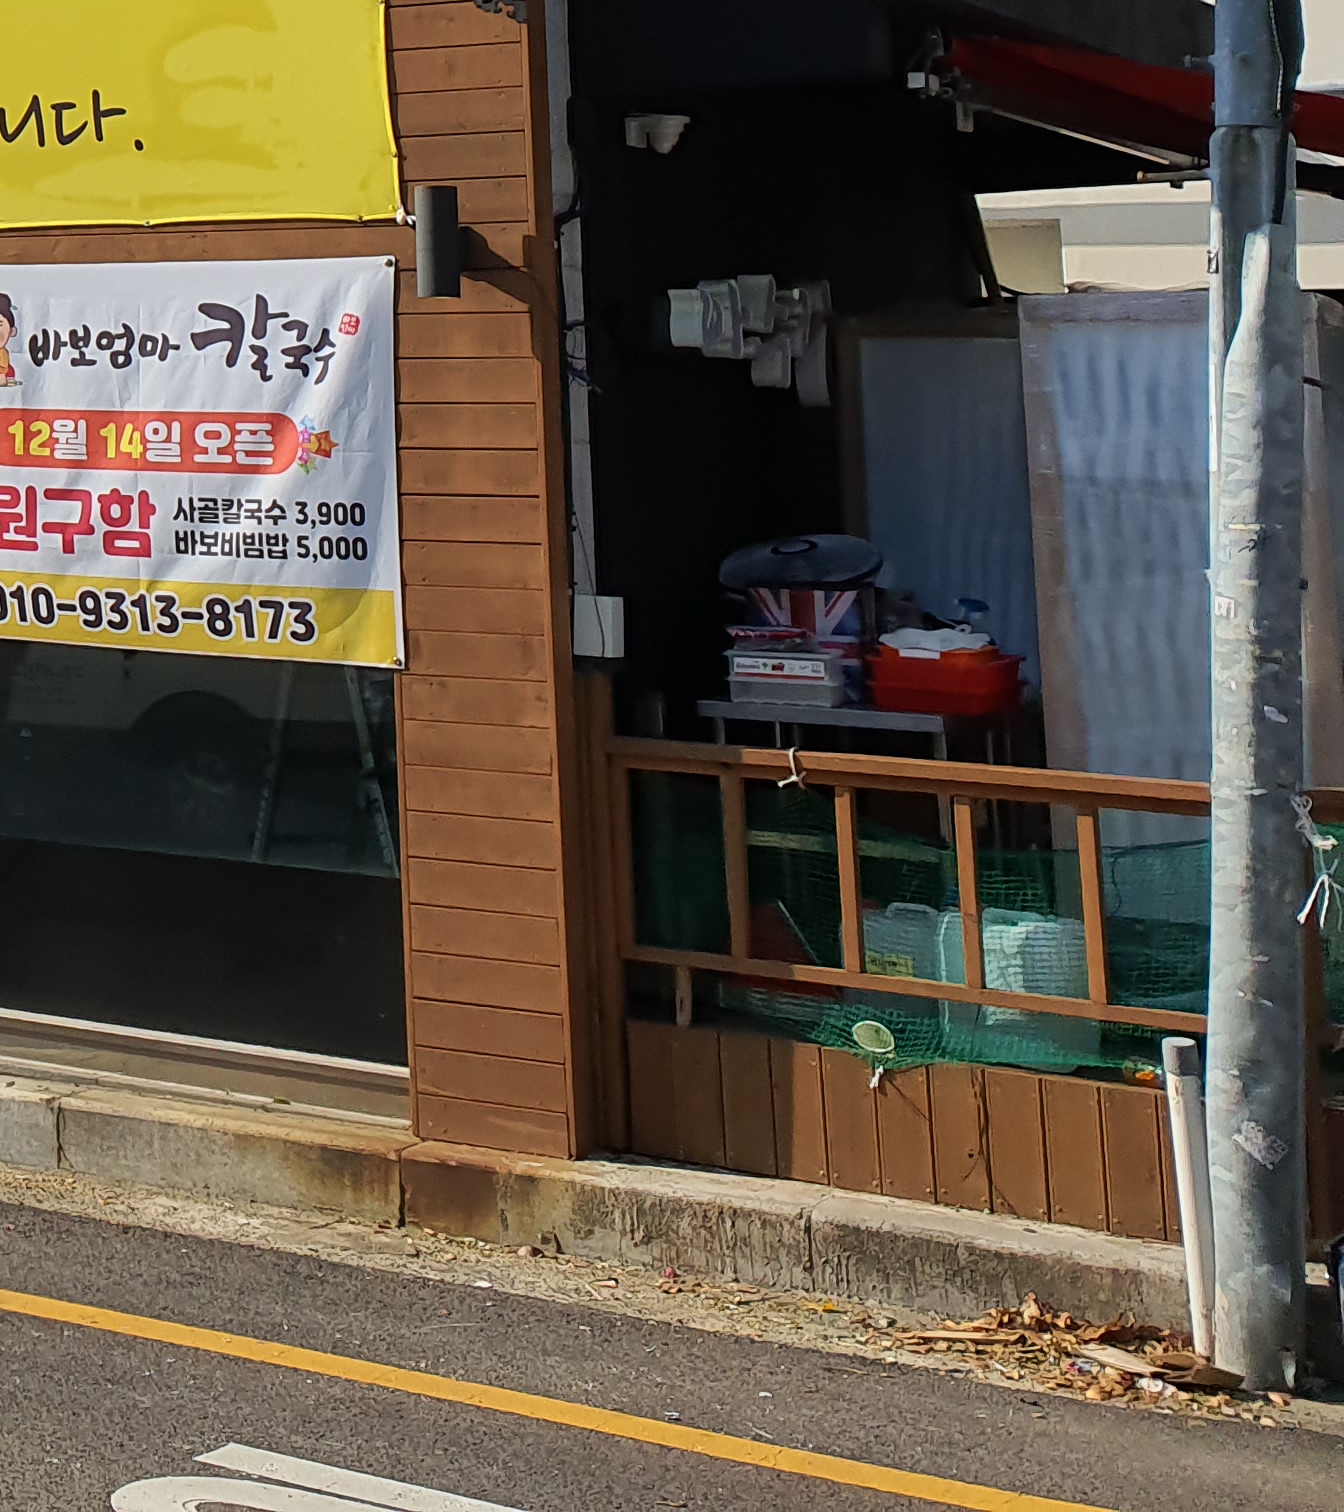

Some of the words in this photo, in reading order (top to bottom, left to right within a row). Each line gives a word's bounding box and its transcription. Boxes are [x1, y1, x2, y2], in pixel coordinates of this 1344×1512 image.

[27, 322, 181, 368] 바보엄마
[190, 293, 338, 386] 칼국수
[7, 418, 88, 461] 12월
[99, 420, 182, 463] 14일
[192, 421, 276, 466] 오픈
[172, 496, 288, 527] 사골칼국수
[294, 500, 367, 530] 3,900
[174, 529, 290, 561] 바보비빔밥
[296, 535, 369, 564] 5,000
